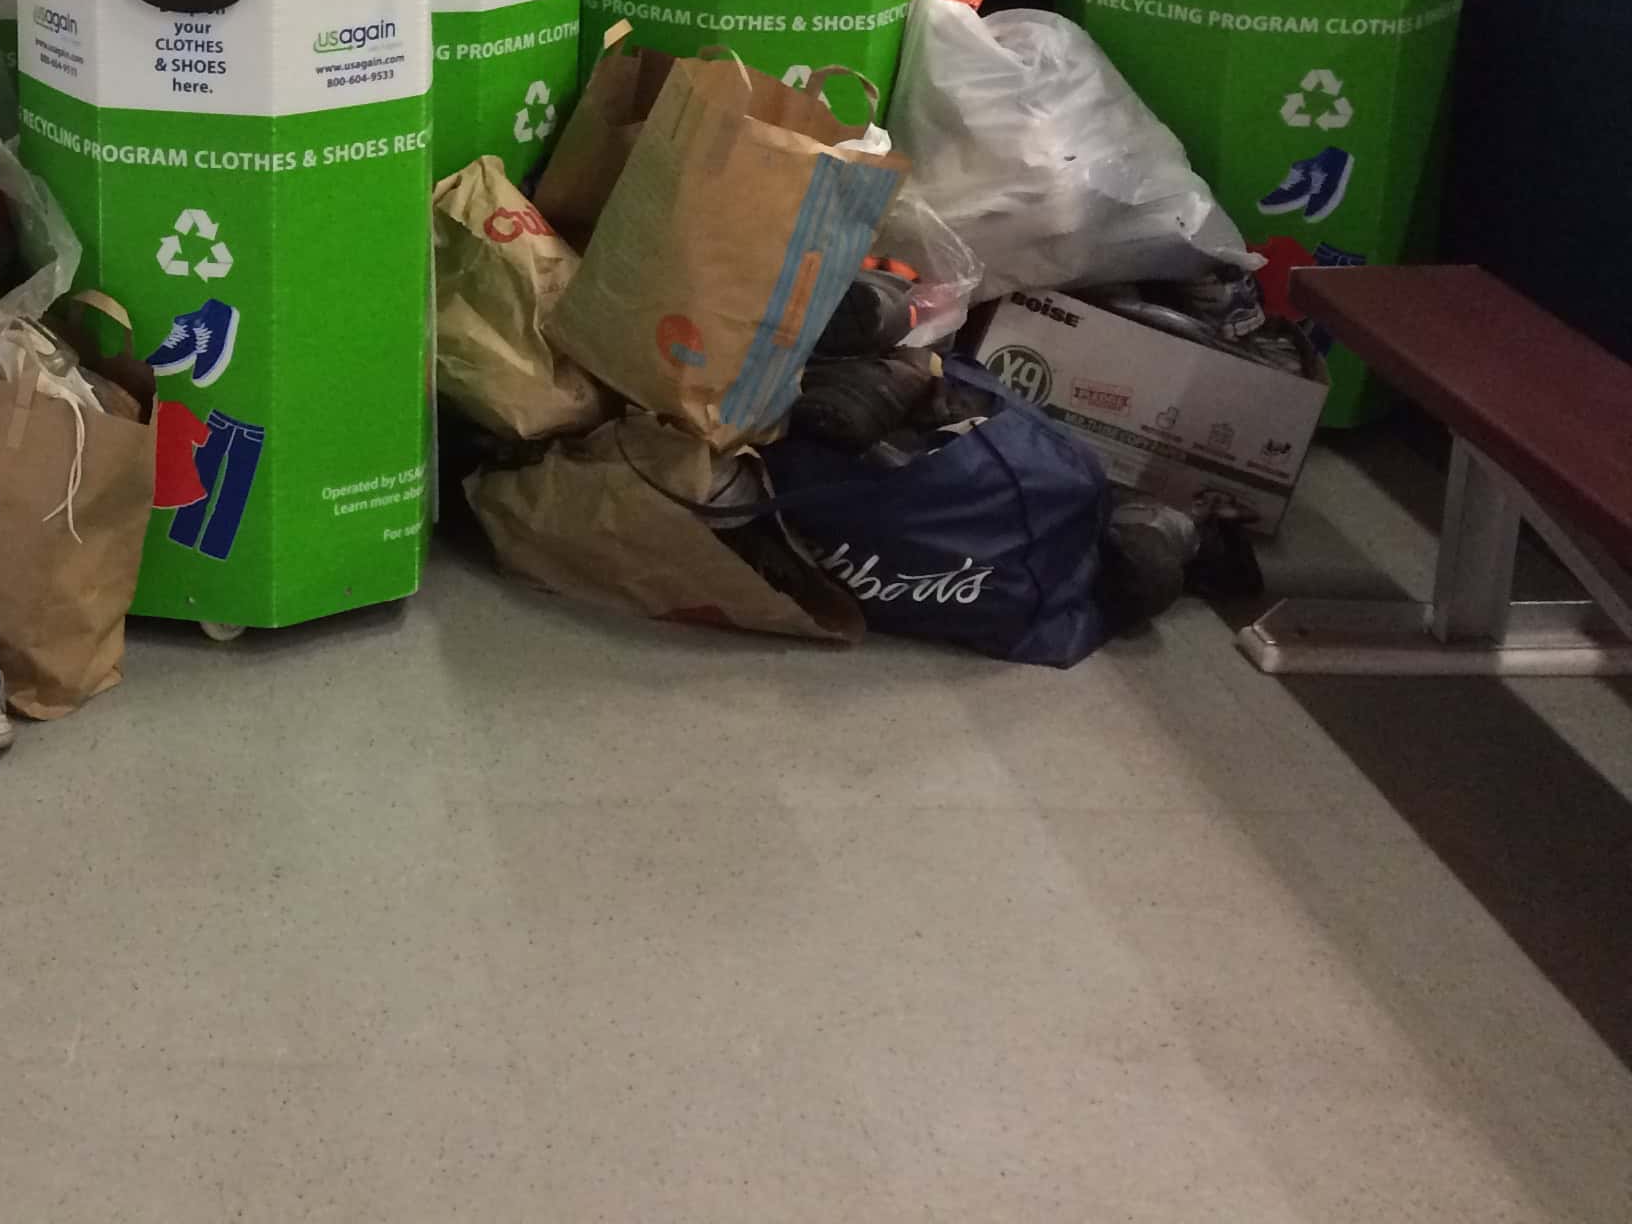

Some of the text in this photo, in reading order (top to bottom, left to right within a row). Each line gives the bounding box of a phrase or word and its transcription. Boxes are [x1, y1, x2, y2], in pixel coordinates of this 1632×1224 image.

[174, 21, 212, 36] your
[696, 12, 786, 33] CLOTHES
[792, 16, 807, 32] &
[812, 15, 875, 32] SHOES
[1208, 10, 1319, 34] PROGRAM
[314, 19, 397, 51] usagain
[456, 32, 535, 60] PROGRAM
[538, 20, 580, 44] CLOTH
[155, 38, 224, 54] CLOTHES
[154, 58, 227, 74] & SHOES
[315, 54, 405, 76] www.usagain.com
[172, 78, 214, 94] here.
[326, 69, 395, 89] 800-604-9533
[22, 107, 81, 153] RECYCLING
[83, 138, 188, 169] PROGRAM
[194, 149, 296, 173] CLOTHES
[302, 149, 317, 167] &
[322, 138, 389, 163] SHOES
[322, 476, 379, 501] Operated
[381, 473, 397, 490] by
[334, 499, 369, 517] Learn
[370, 493, 401, 509] more
[384, 526, 402, 542] For
